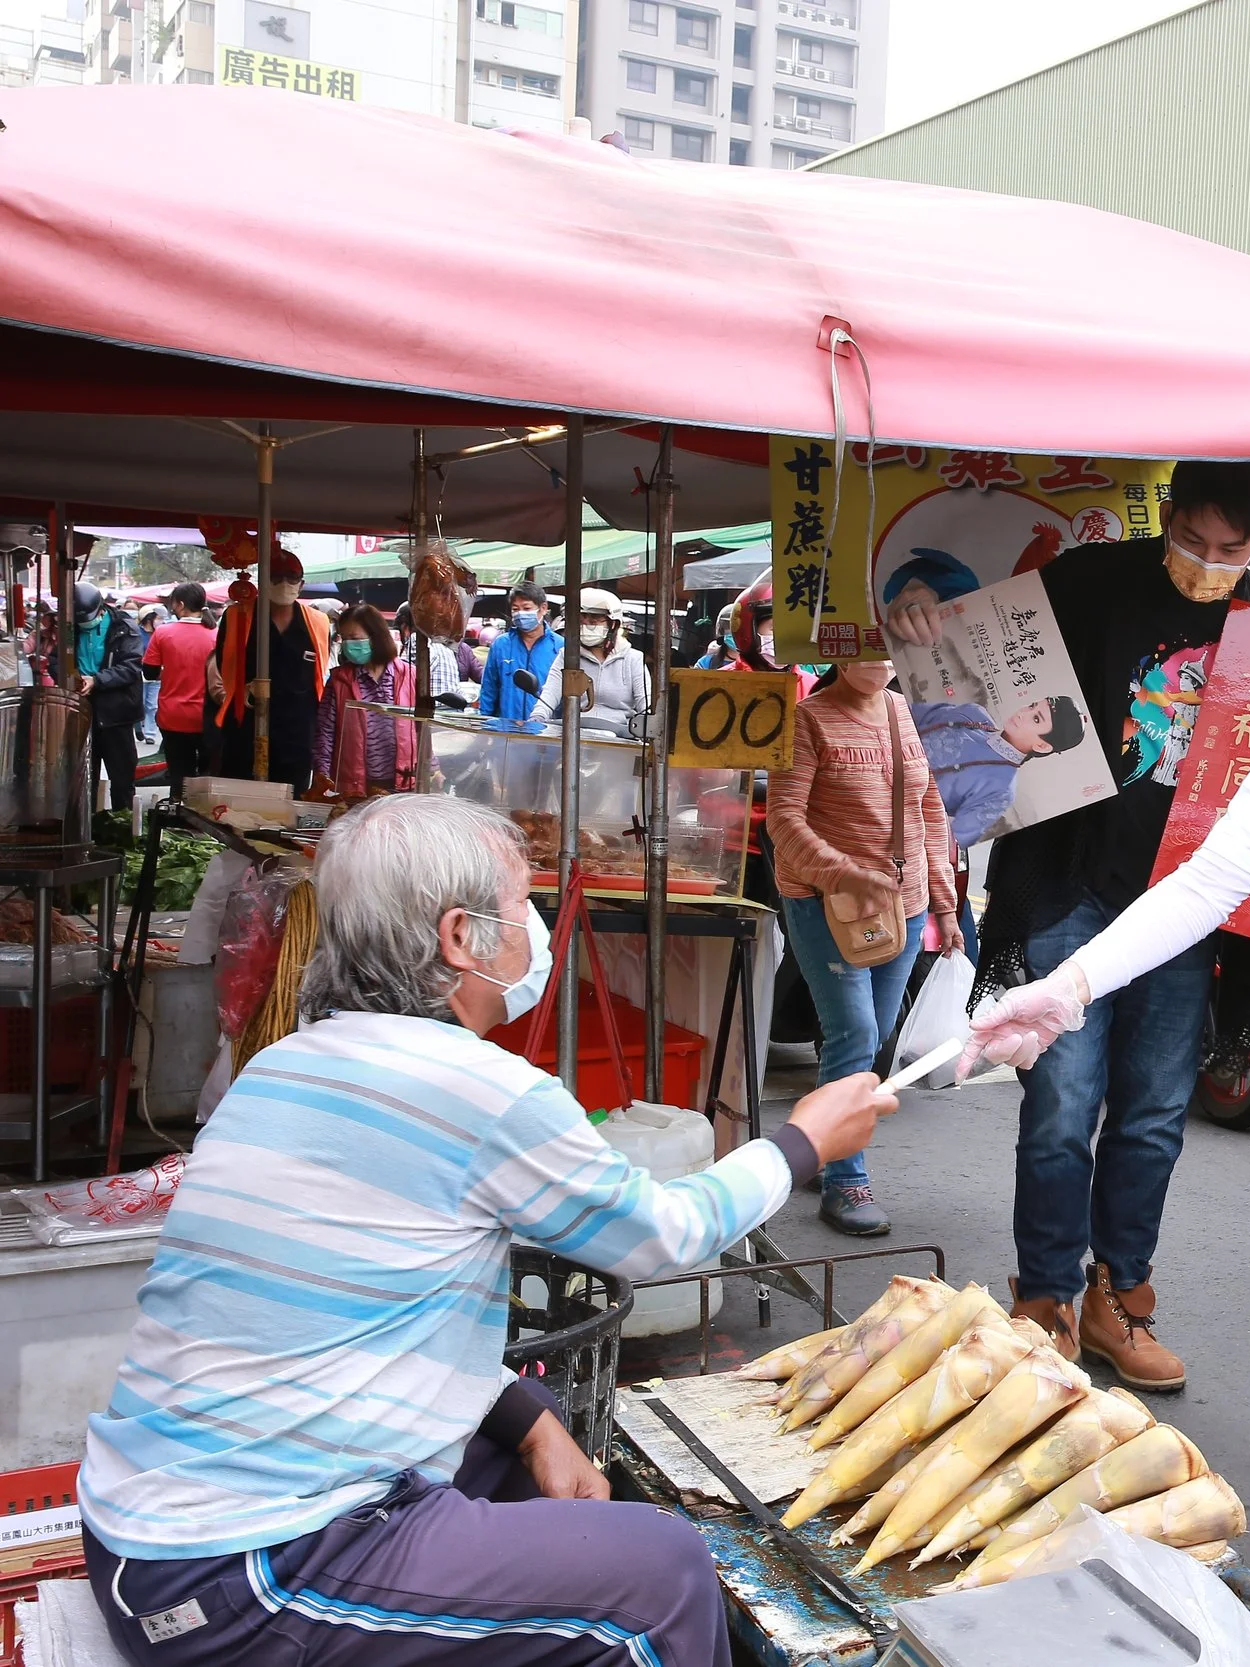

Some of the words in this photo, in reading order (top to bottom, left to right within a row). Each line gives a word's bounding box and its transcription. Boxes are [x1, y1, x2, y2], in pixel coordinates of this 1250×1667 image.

[223, 49, 355, 101] 廣告出租
[783, 443, 837, 618] 甘蔗雞
[975, 622, 1001, 674] 2022.2.24
[668, 682, 786, 751] 100
